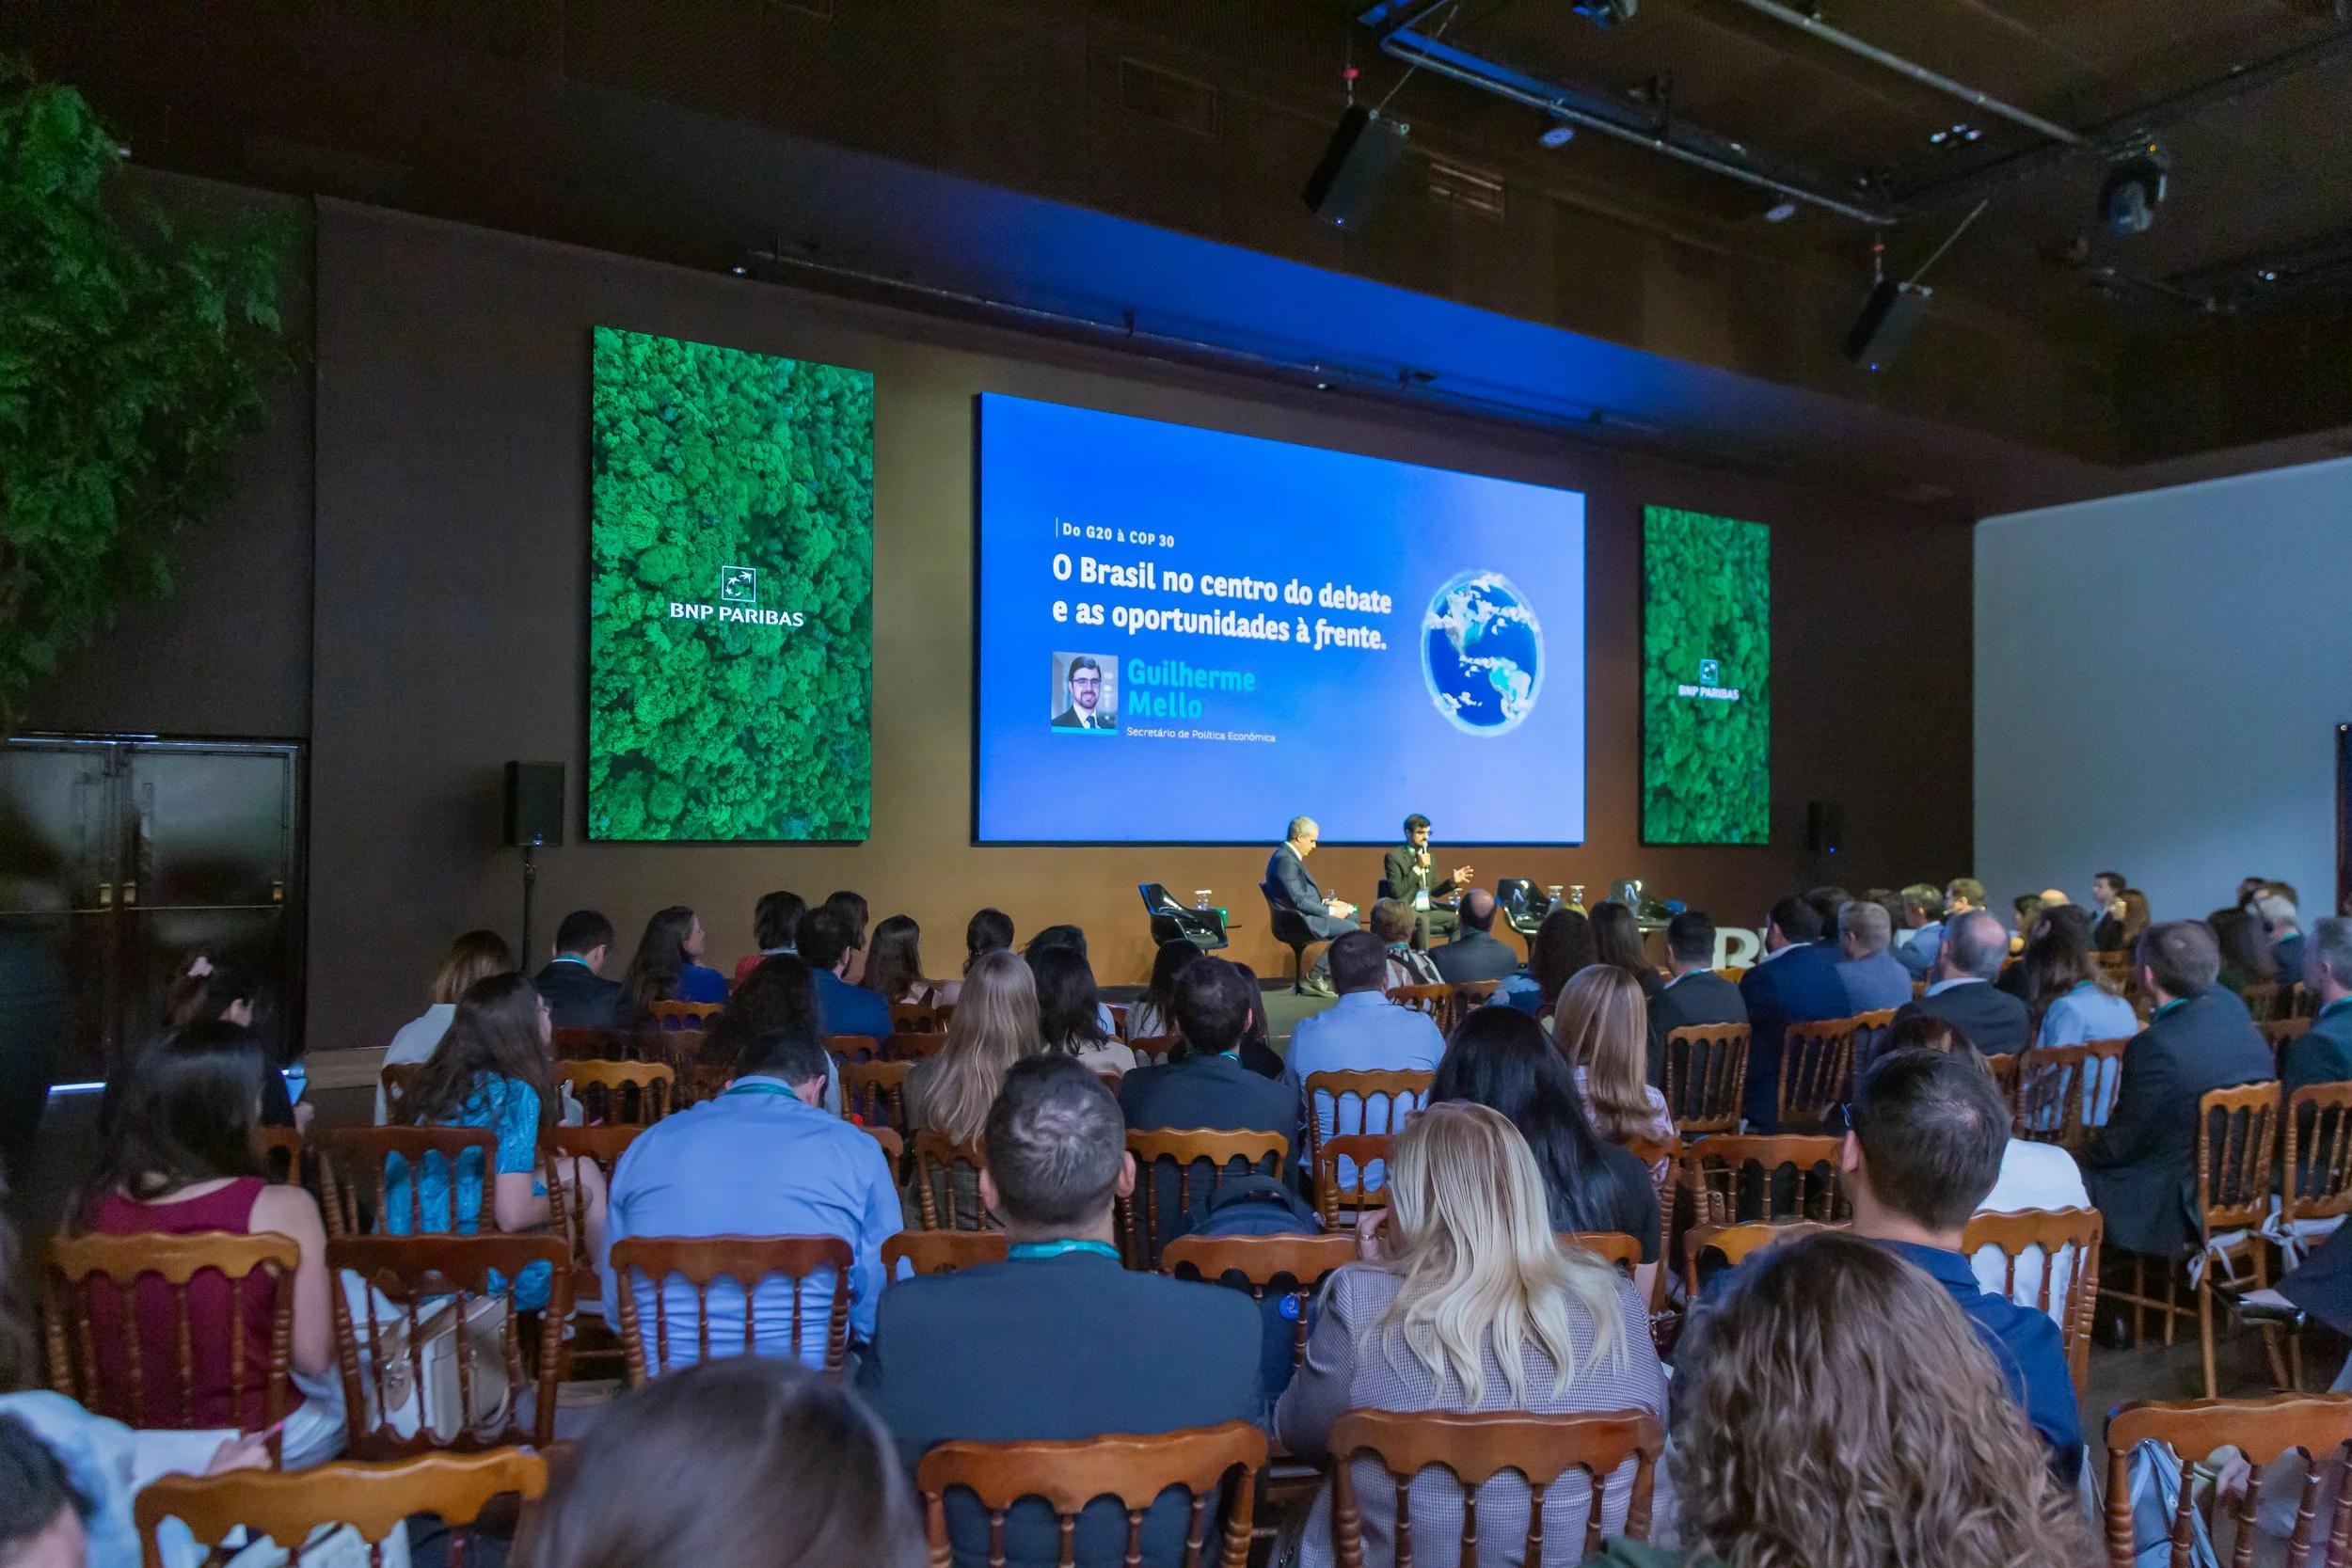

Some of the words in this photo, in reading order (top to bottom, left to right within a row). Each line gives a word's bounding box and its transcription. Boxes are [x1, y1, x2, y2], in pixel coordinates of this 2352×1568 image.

[1062, 522, 1081, 537] Do
[1086, 525, 1113, 541] G20
[1117, 528, 1125, 543] à
[1129, 531, 1156, 546] COP
[1159, 534, 1175, 548] 30
[1052, 553, 1073, 581] O
[1080, 556, 1156, 591] Brasil
[1163, 570, 1194, 594] no
[1200, 575, 1279, 603] centro
[1283, 578, 1313, 606] do
[1318, 581, 1392, 614] debate
[670, 602, 714, 620] BNP
[719, 606, 804, 627] PARIBAS
[1052, 600, 1068, 623] e
[1075, 602, 1105, 626] as
[1112, 605, 1291, 641] oportunidades
[1295, 616, 1311, 644] à
[1313, 618, 1388, 651] frente.
[1127, 658, 1257, 691] Guilherme
[1128, 689, 1204, 720] Mello
[1677, 684, 1699, 697] BNP
[1699, 686, 1740, 702] PARIBAS
[1126, 726, 1176, 738] Secretário
[1178, 729, 1190, 739] de
[1192, 729, 1226, 741] Política
[1228, 731, 1277, 743] Econômica
